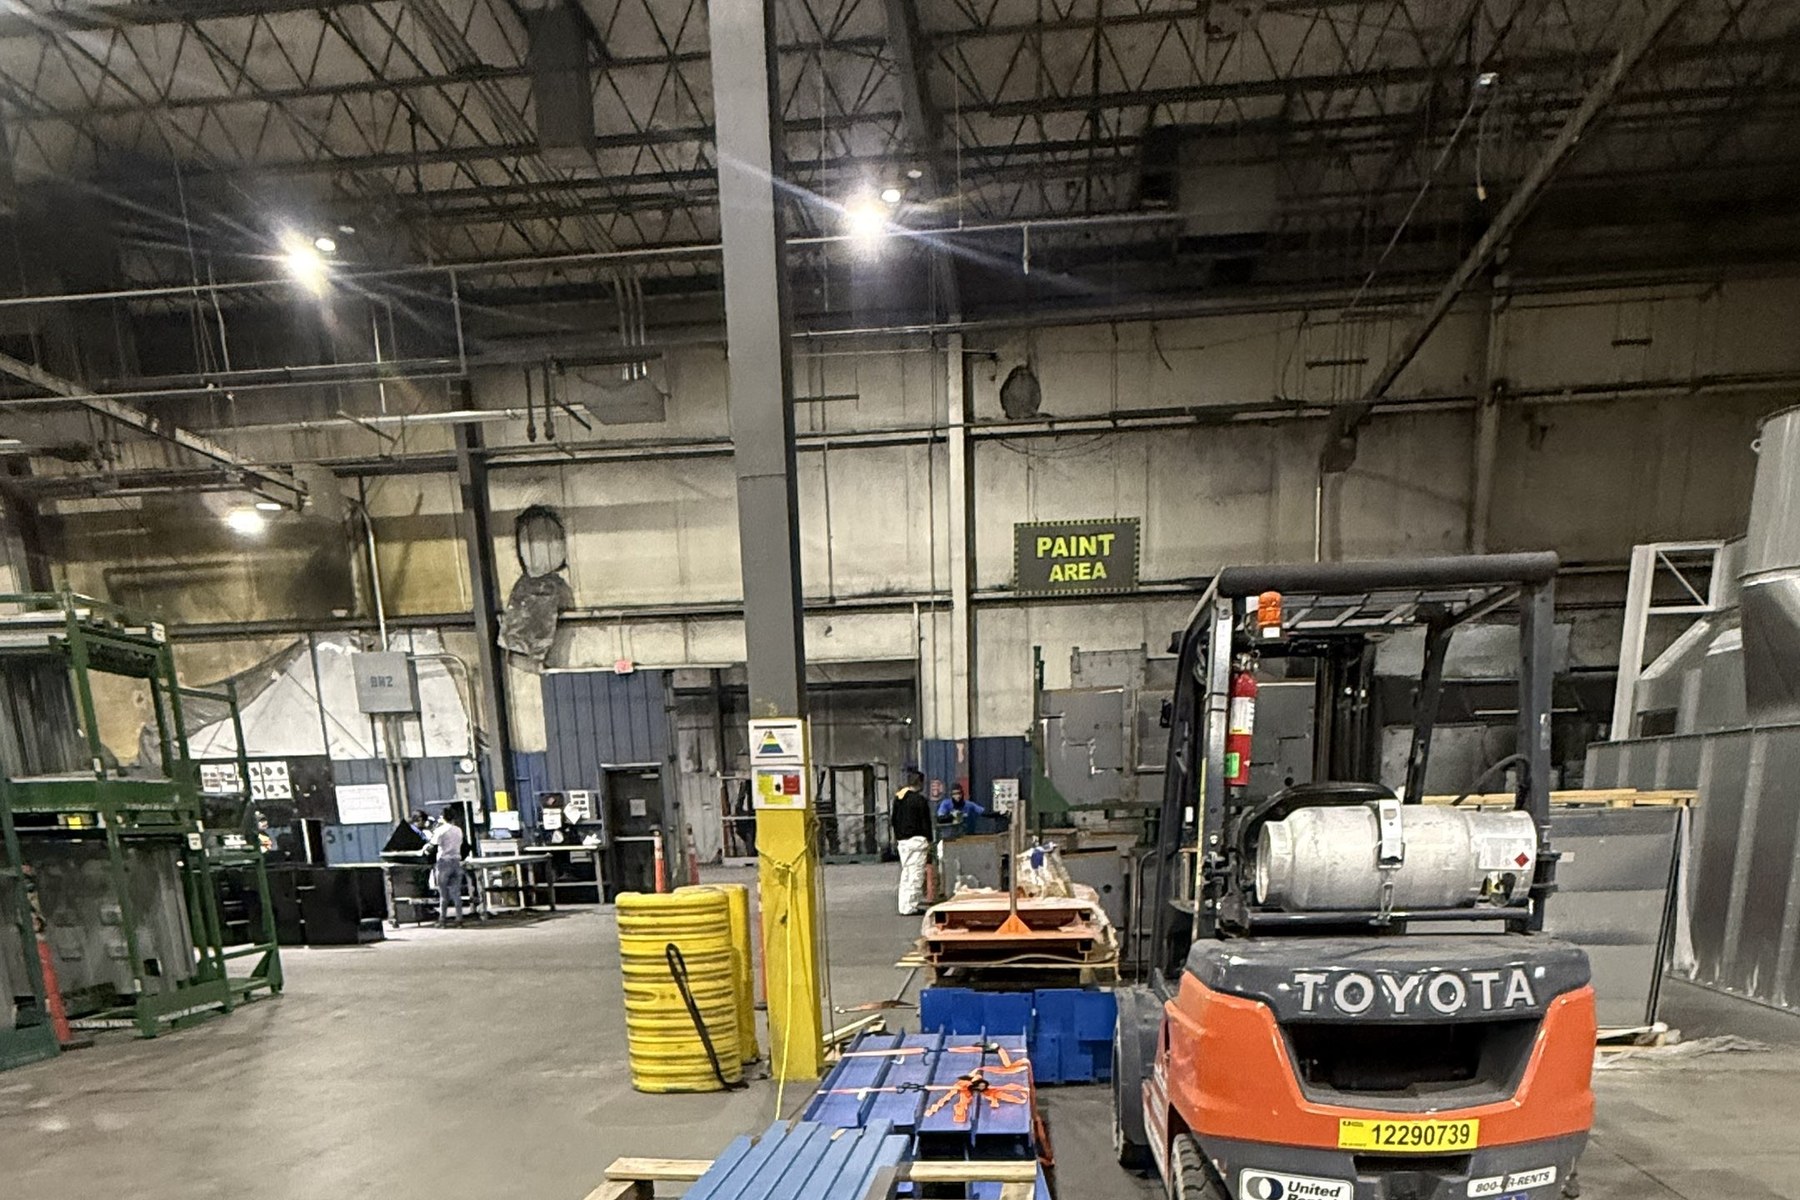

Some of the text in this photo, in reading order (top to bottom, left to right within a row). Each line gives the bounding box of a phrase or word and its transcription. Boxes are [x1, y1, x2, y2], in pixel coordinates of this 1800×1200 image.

[1036, 533, 1115, 558] PAINT
[1048, 561, 1107, 582] AREA
[1294, 968, 1536, 1014] TOYOTA
[1371, 1123, 1470, 1146] 12290739
[1287, 1180, 1341, 1198] United
[1475, 1171, 1550, 1193] 800-R-RENTS
